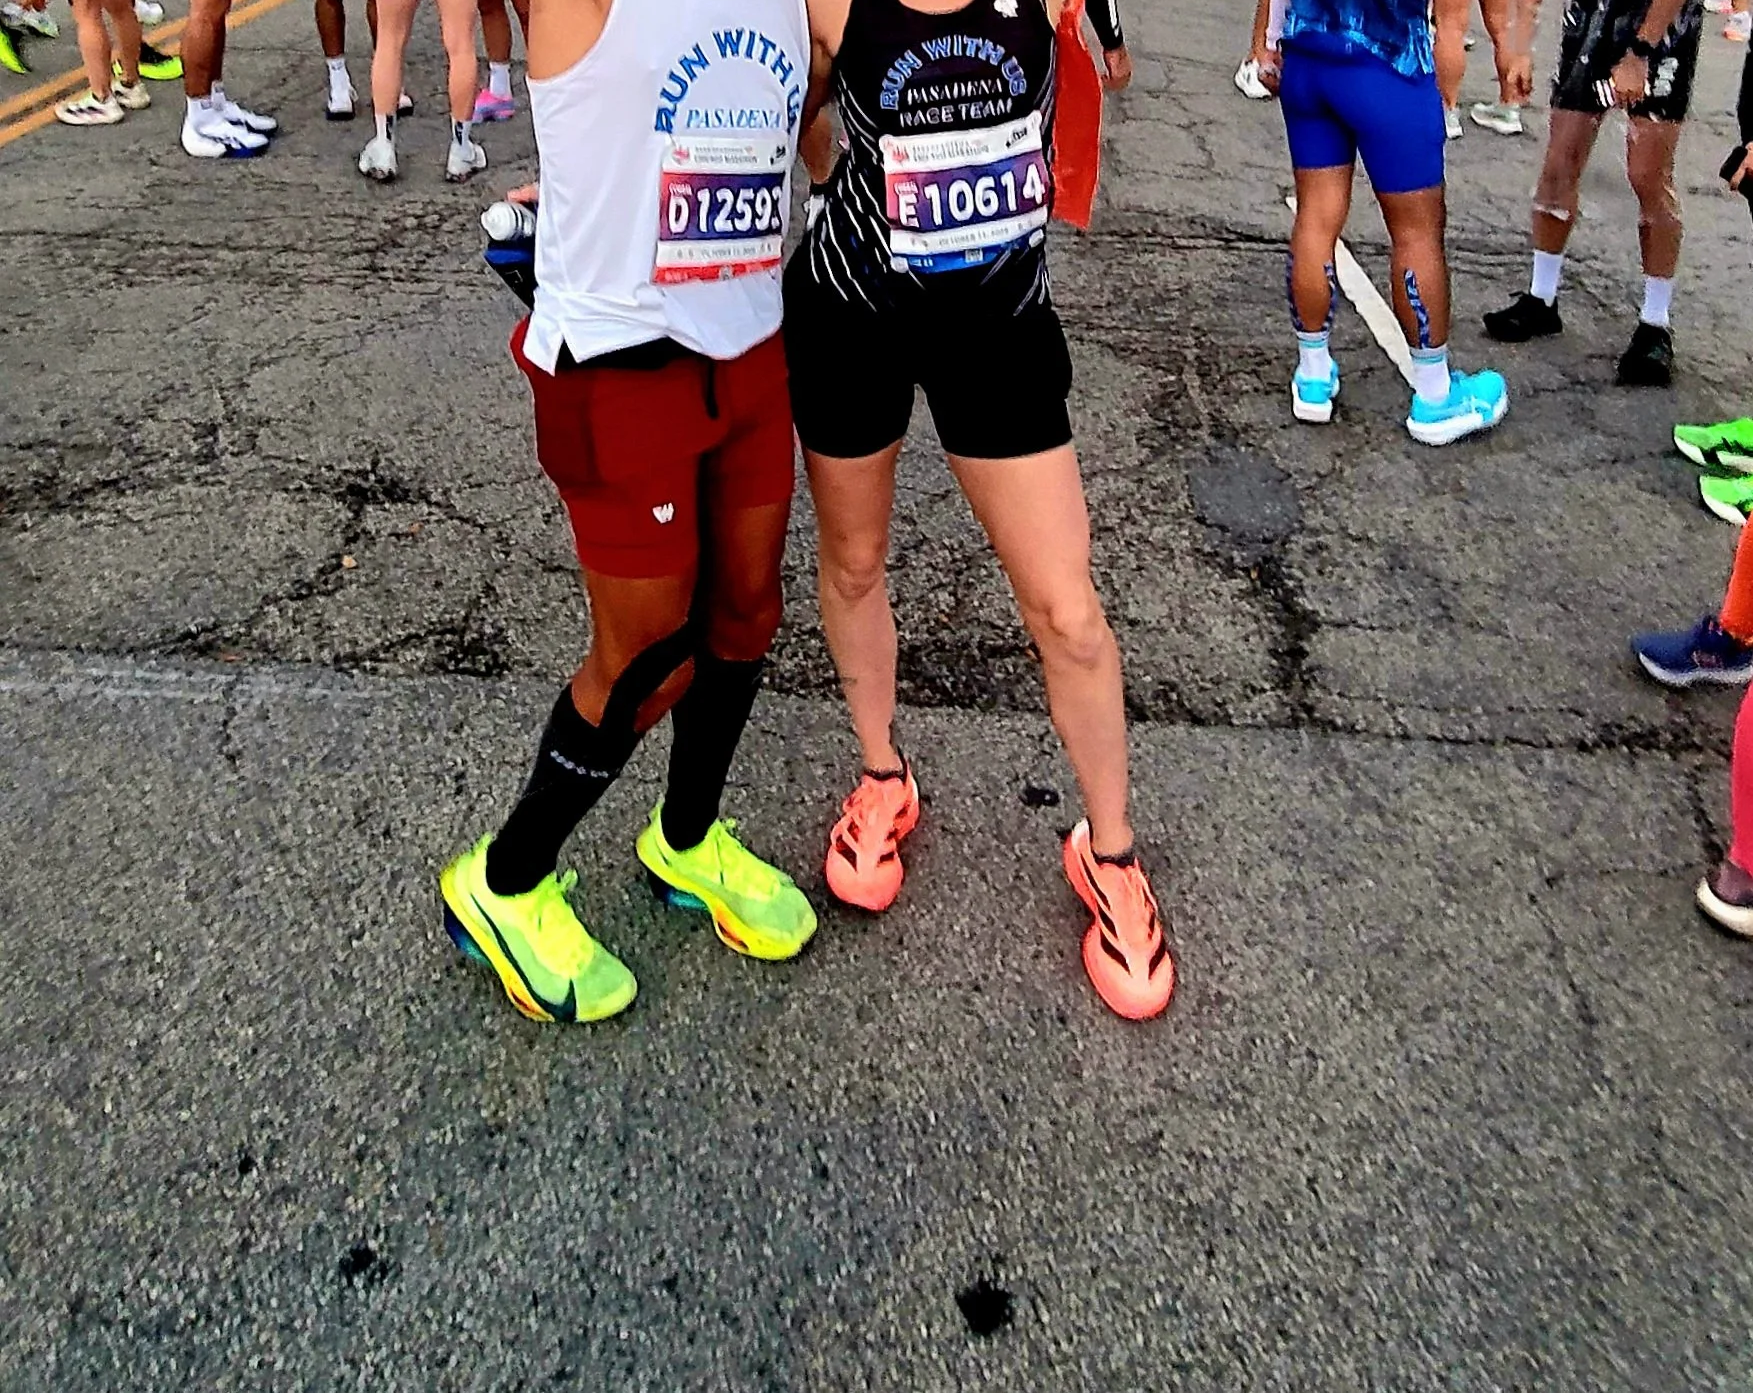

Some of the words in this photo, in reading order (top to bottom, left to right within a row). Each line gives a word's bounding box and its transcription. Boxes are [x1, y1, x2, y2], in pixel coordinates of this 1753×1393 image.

[654, 41, 711, 135] RUN
[711, 27, 795, 88] WITH
[880, 49, 923, 111] RUN
[921, 34, 1006, 66] WITH
[907, 78, 1003, 105] PASADENA
[686, 108, 782, 129] PASADENA
[900, 104, 955, 128] RACE
[958, 97, 1013, 120] TEAM
[668, 195, 690, 234] D
[898, 192, 920, 228] E
[923, 163, 1046, 226] 10614
